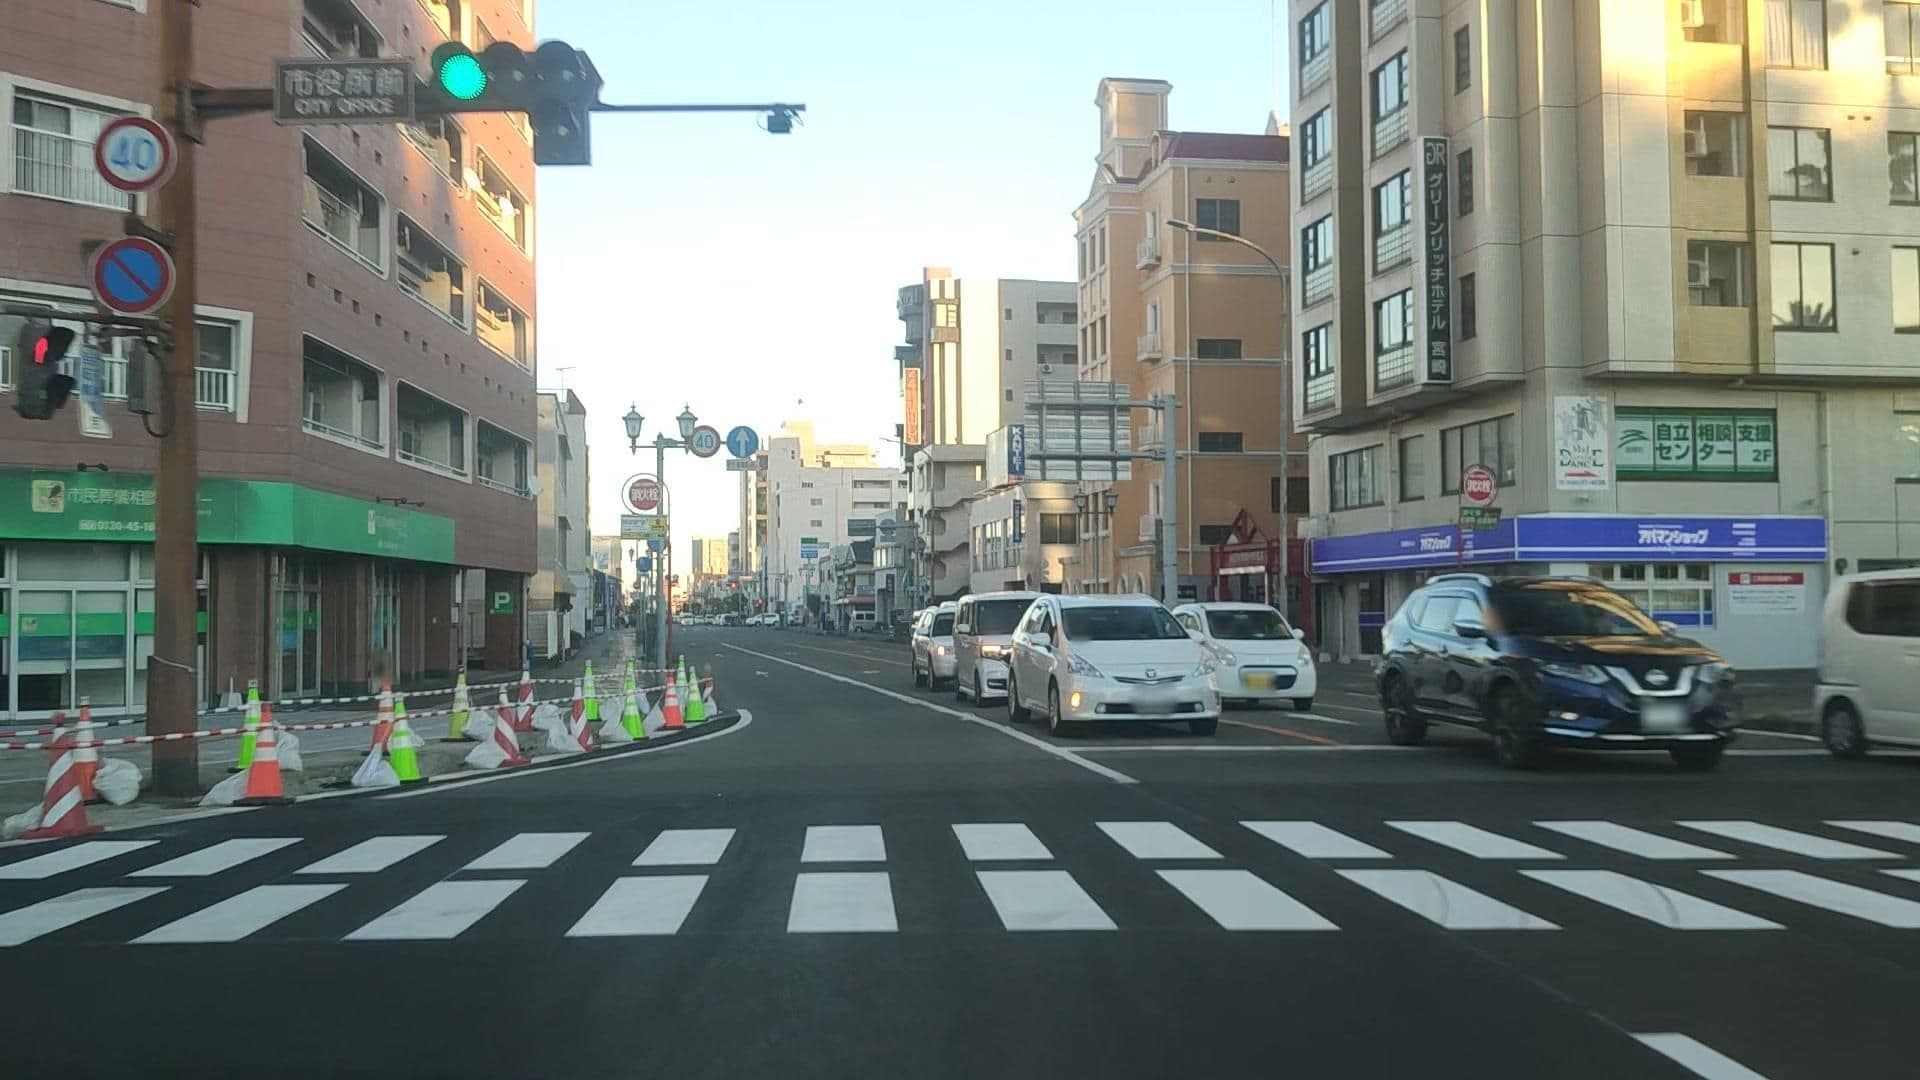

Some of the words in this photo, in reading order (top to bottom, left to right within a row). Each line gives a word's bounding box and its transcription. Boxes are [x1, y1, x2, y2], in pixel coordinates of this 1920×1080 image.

[282, 67, 404, 96] 市役所前
[294, 97, 332, 115] CITY
[336, 97, 394, 115] OFFICE
[110, 135, 156, 171] 40
[1429, 172, 1447, 330] グリーンリッチホテル
[695, 434, 714, 449] 40
[1752, 449, 1773, 462] 2F
[631, 488, 659, 502] 消火栓
[1637, 528, 1709, 546] アパマンショップ
[494, 591, 511, 609] P
